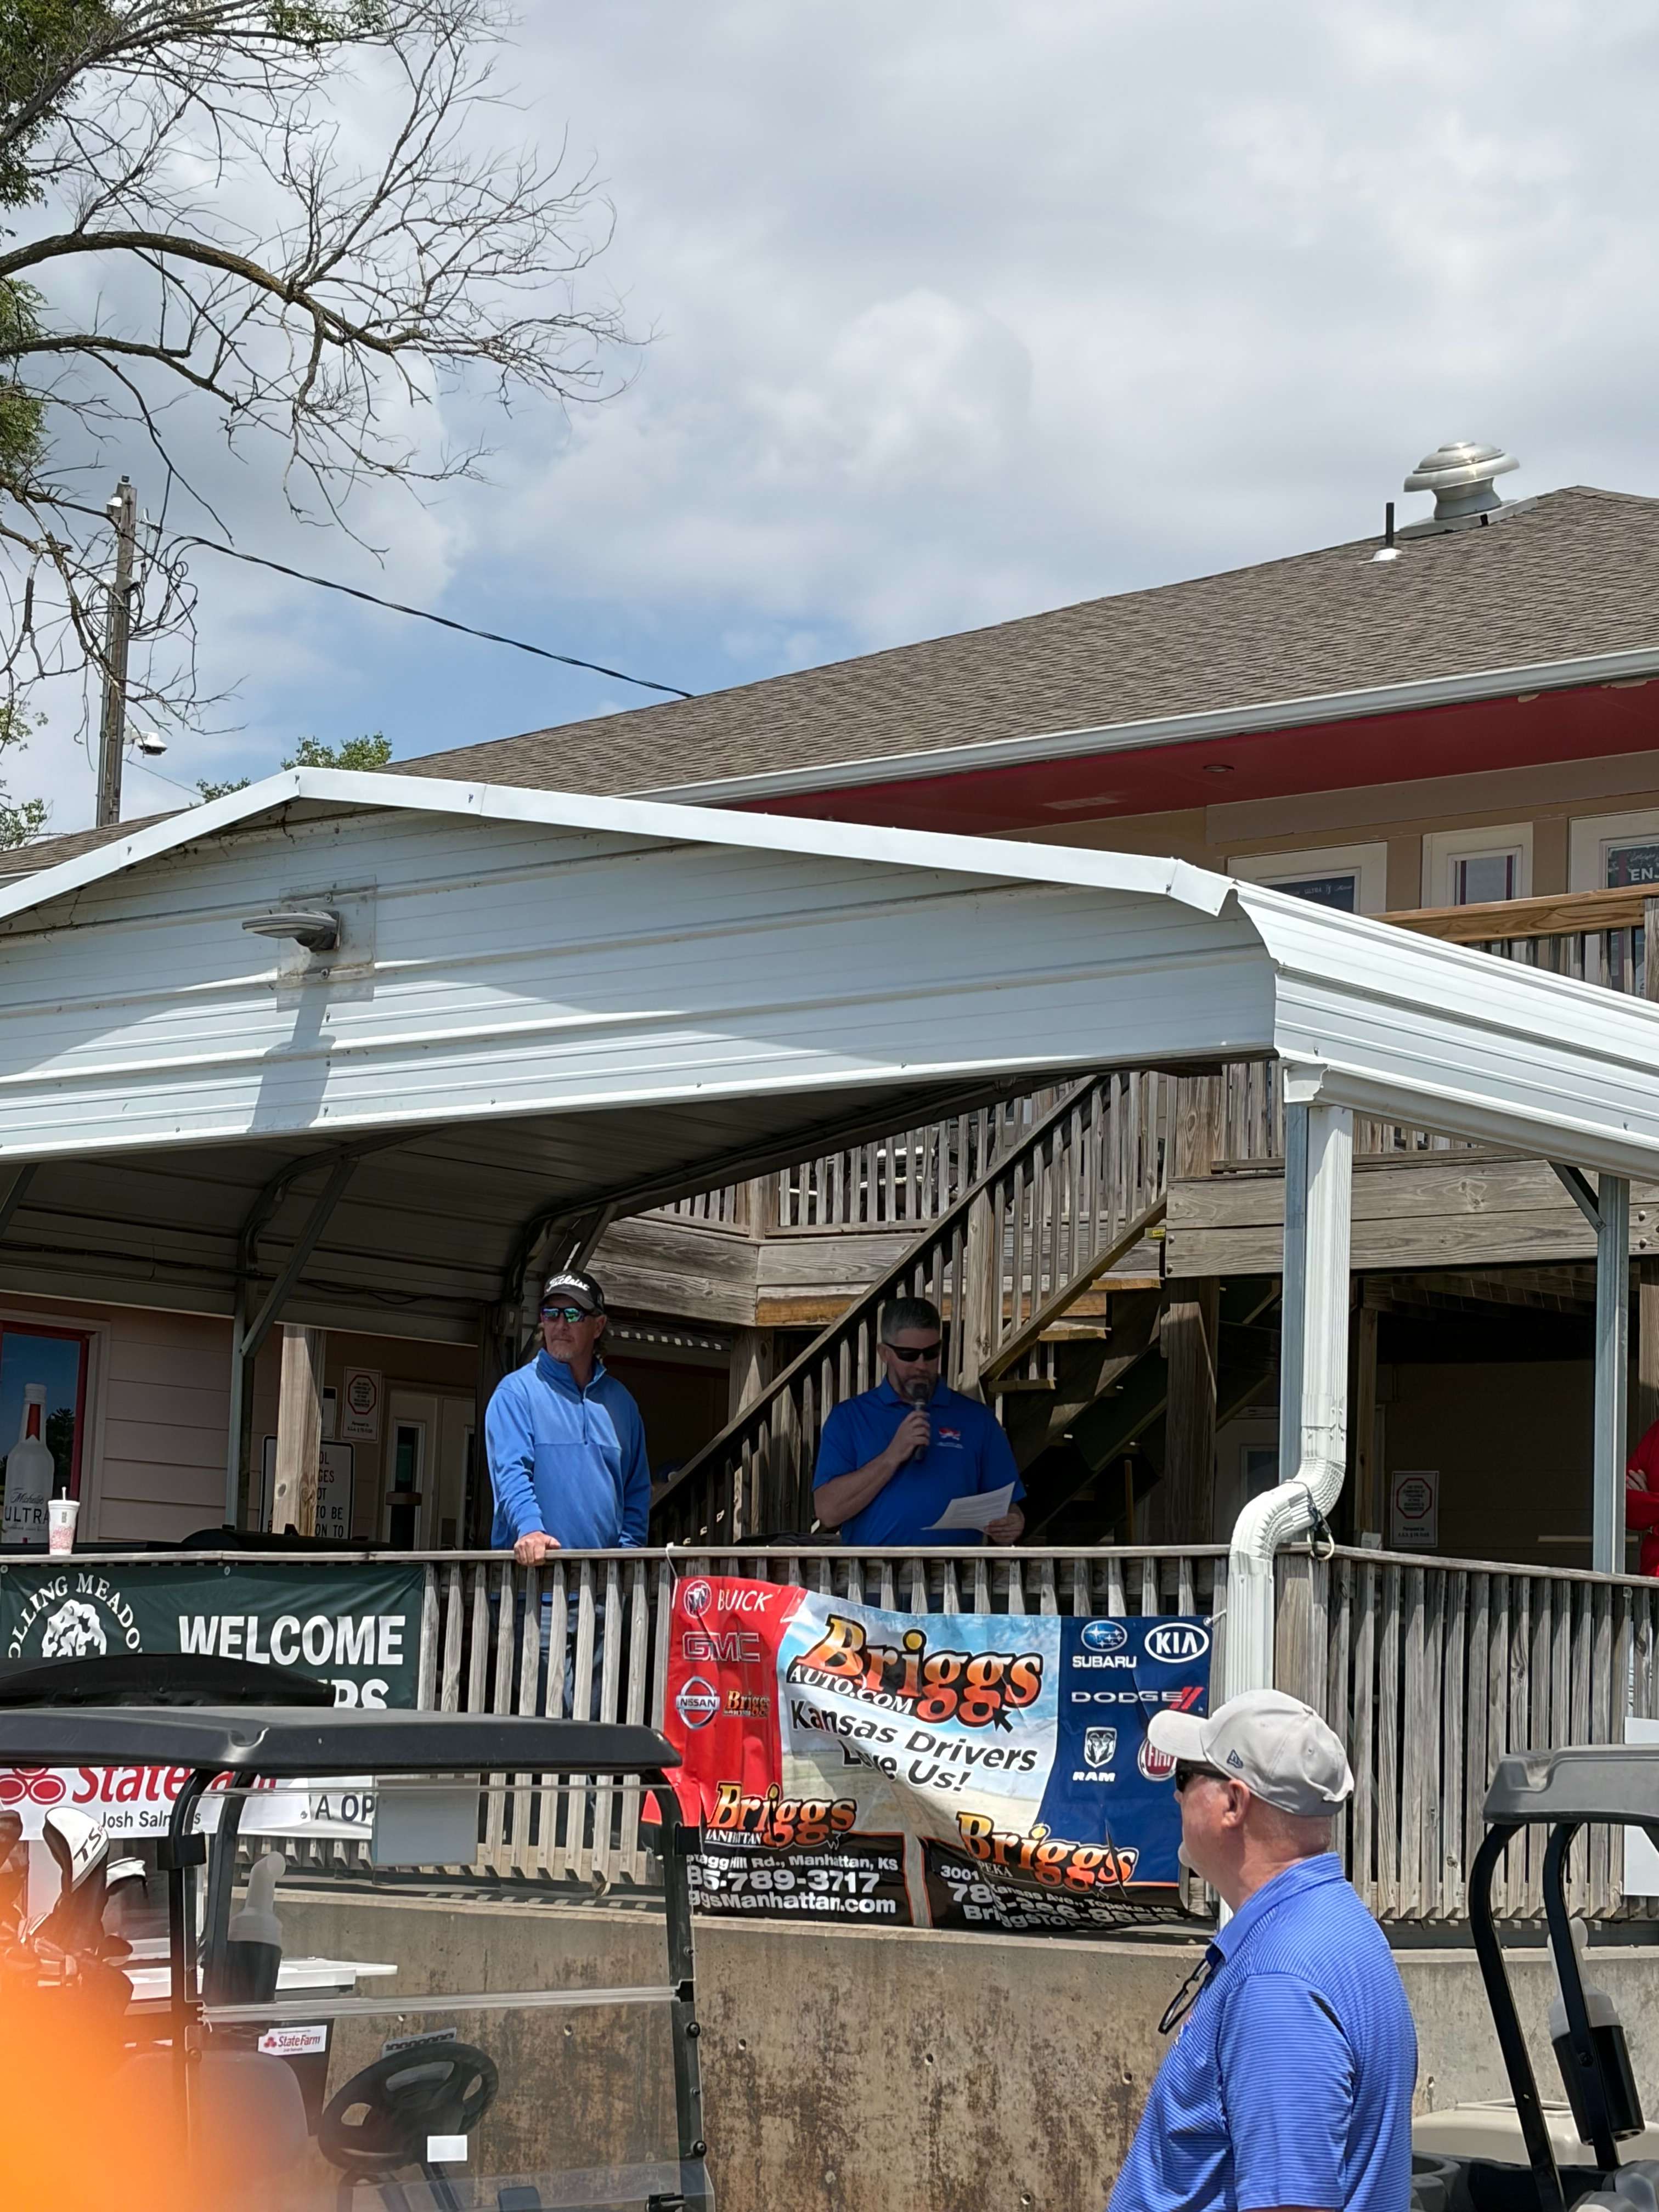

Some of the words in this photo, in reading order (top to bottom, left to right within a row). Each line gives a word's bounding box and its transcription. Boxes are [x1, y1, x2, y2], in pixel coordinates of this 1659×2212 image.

[317, 1487, 327, 1500] OT
[331, 1506, 343, 1520] BE
[333, 1524, 344, 1537] TO
[717, 1589, 773, 1612] BUICK
[8, 1576, 68, 1658] OLLING
[76, 1572, 143, 1653] MEADO
[178, 1615, 406, 1666] WELCOME
[682, 1631, 760, 1662] GMC
[1156, 1632, 1198, 1655] KIA
[795, 1615, 1043, 1726] Briggs
[1072, 1656, 1137, 1668] SUBARU
[680, 1698, 716, 1708] NISSAN
[789, 1667, 915, 1716] AUTO.COM
[1071, 1690, 1183, 1703] DODGE
[791, 1700, 899, 1743] Kansas
[905, 1730, 1037, 1772] Drivers
[907, 1760, 971, 1792] Us!
[1073, 1771, 1116, 1782] RAM
[101, 1810, 133, 1828] Josh
[341, 1795, 375, 1822] OP
[708, 1782, 857, 1847] Briggs
[788, 1854, 874, 1871] Manhattan,
[958, 1812, 1138, 1892] Briggs
[687, 1865, 880, 1893] 85-789-3717
[940, 1865, 980, 1881] 3001
[977, 1860, 1013, 1877] PEKA
[689, 1890, 896, 1913] ggsManhattan.com
